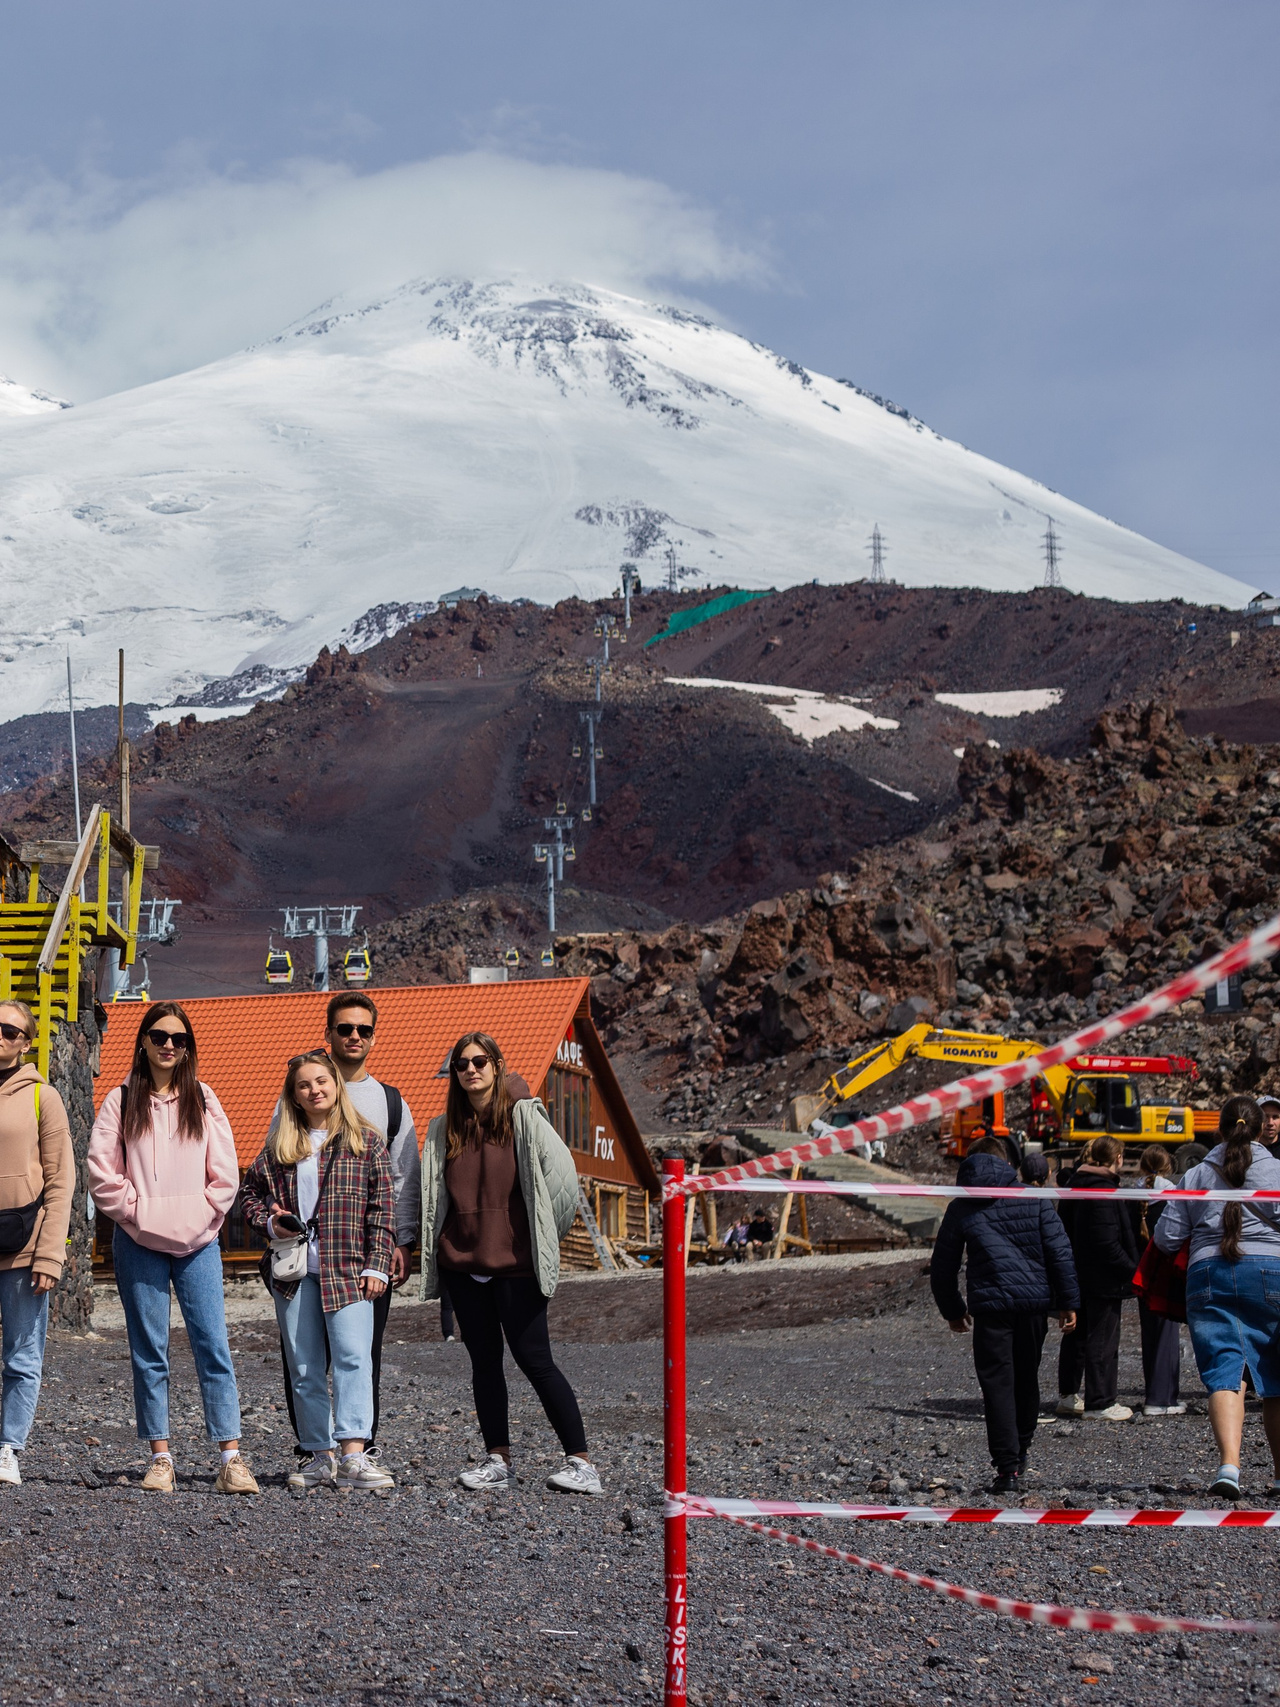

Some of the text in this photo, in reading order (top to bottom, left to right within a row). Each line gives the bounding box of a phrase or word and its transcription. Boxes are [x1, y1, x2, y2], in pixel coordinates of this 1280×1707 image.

[556, 1039, 584, 1067] КАФЕ
[943, 1047, 998, 1059] KOMATSU
[1167, 1124, 1183, 1133] 200
[672, 1584, 687, 1687] LISKI
